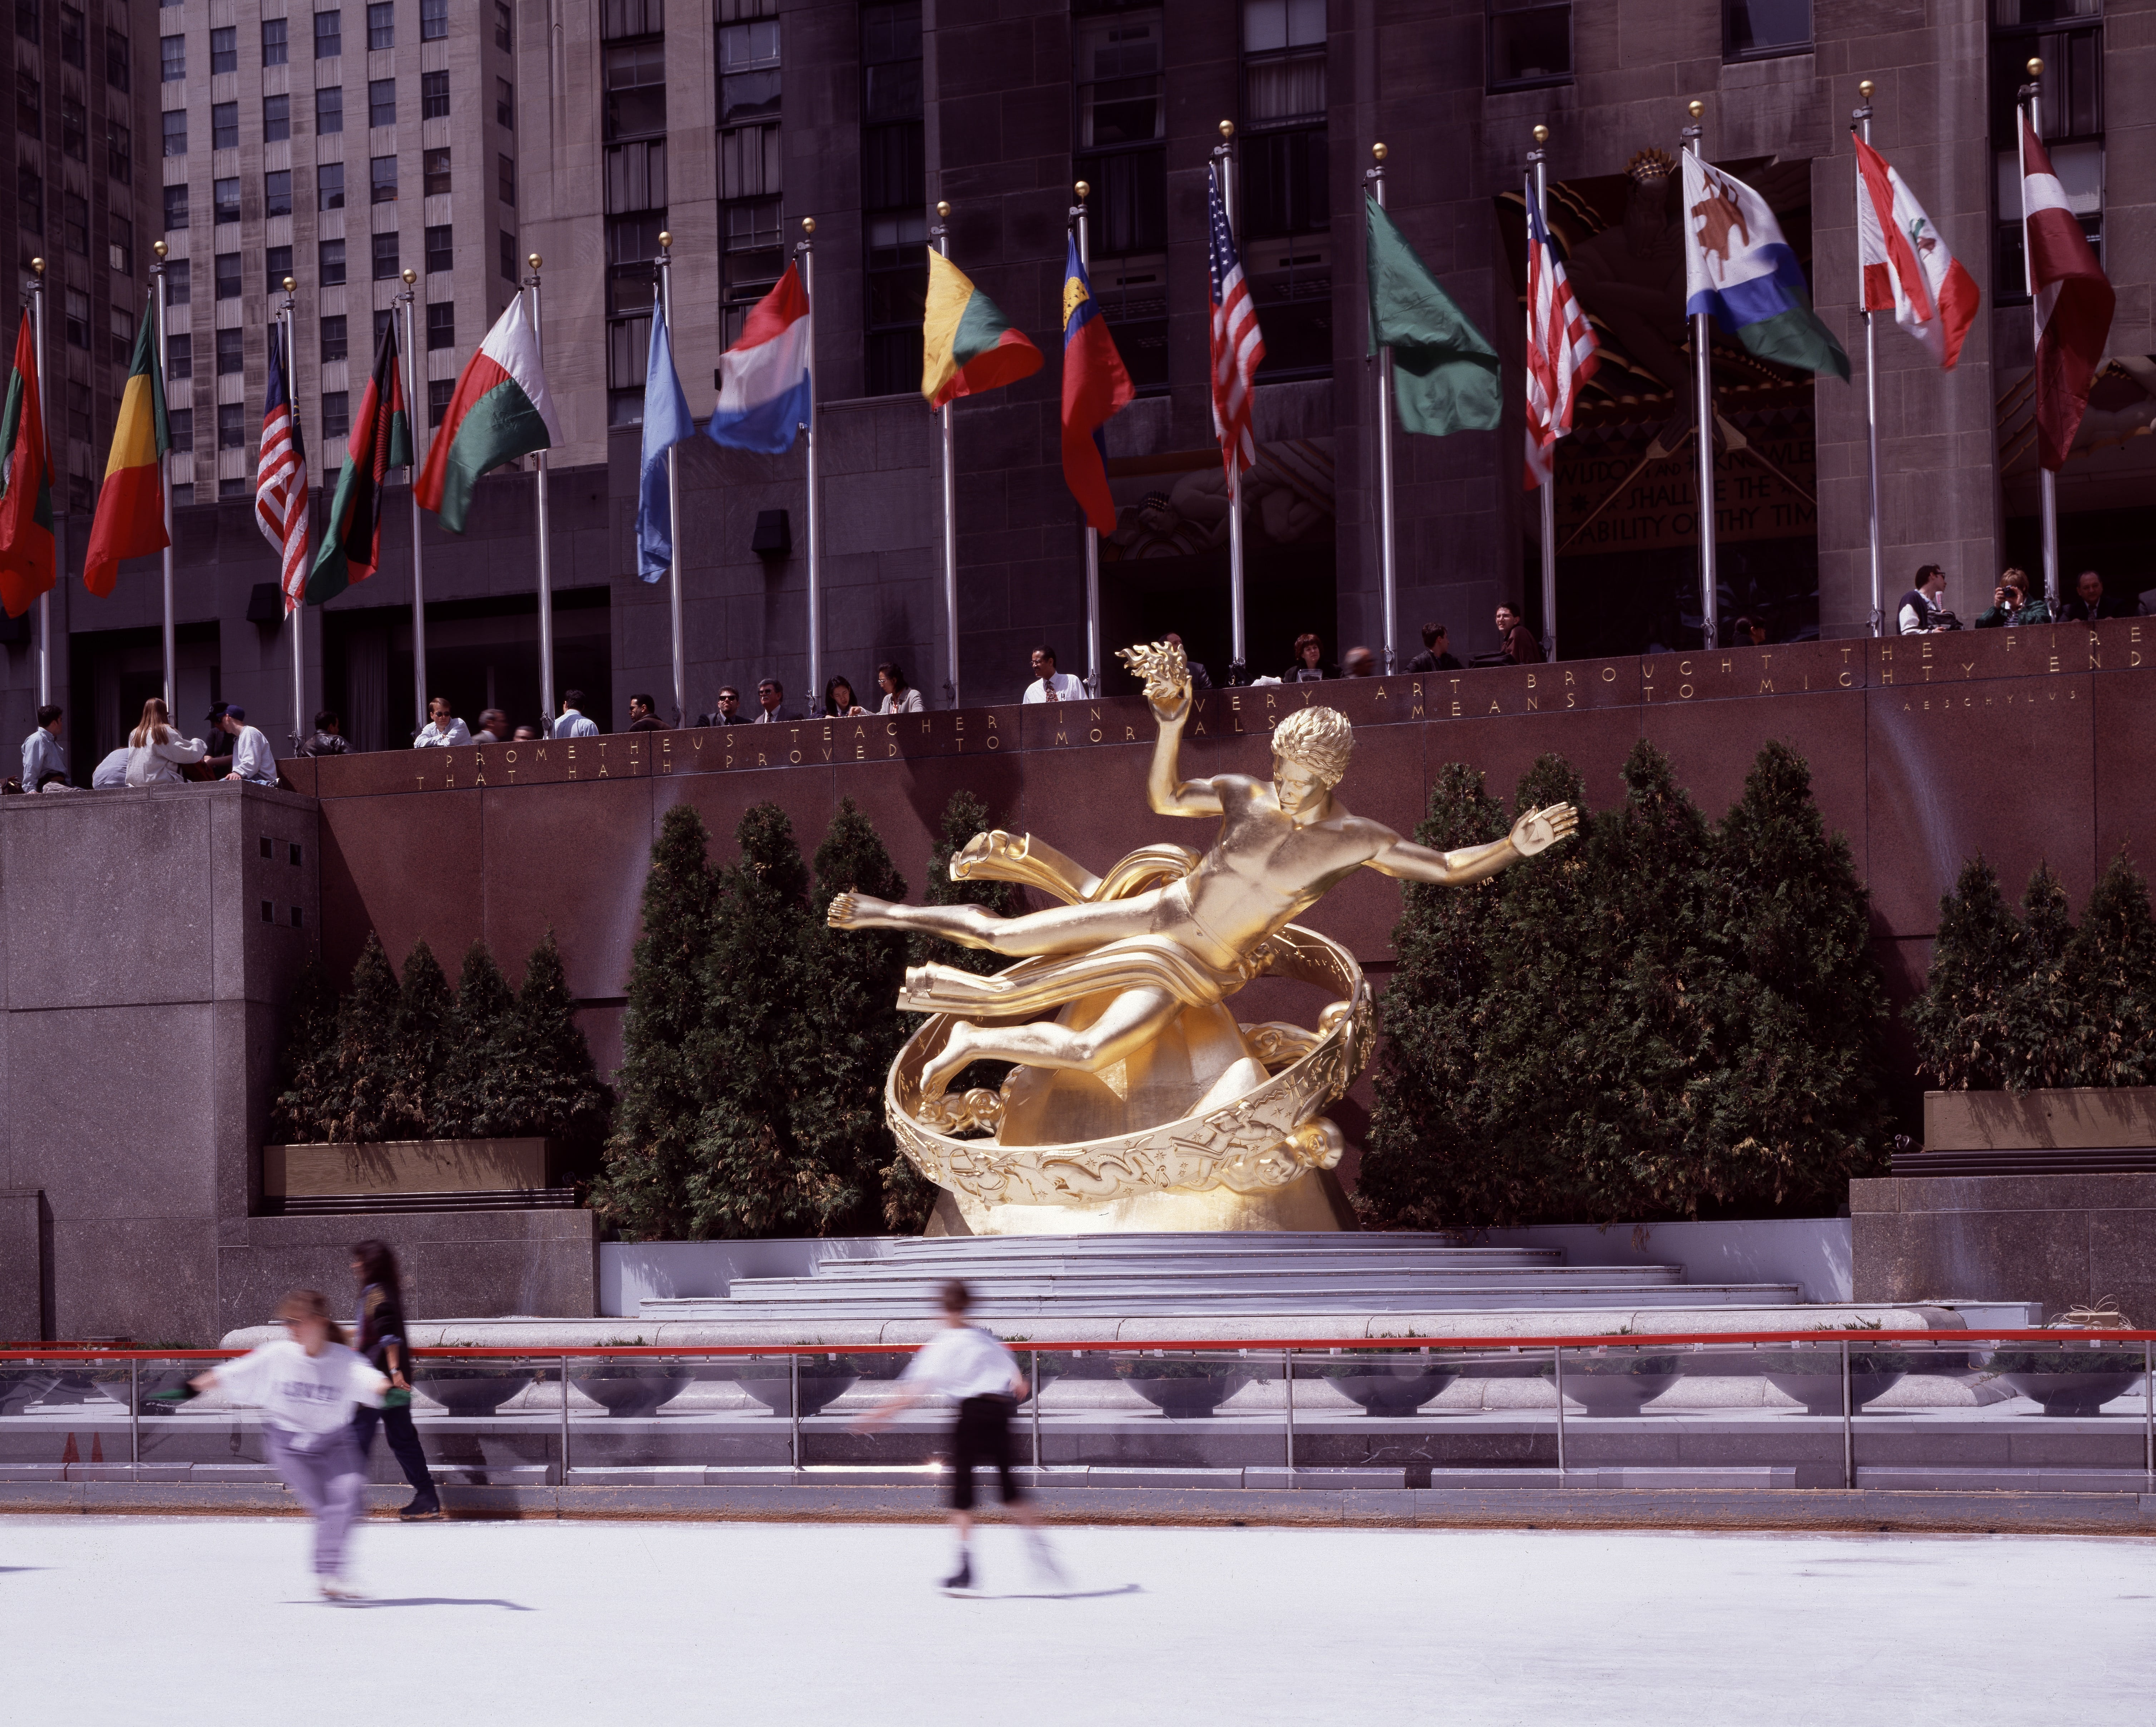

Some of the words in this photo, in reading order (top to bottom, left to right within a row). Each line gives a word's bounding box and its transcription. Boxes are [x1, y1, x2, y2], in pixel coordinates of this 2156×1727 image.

[1655, 463, 1681, 478] AND
[1713, 440, 1816, 471] KNWLE
[1627, 483, 1693, 510] SHALL
[1734, 475, 1771, 499] THE
[1555, 515, 1667, 545] STABILITY
[1715, 506, 1761, 532] THY
[446, 734, 733, 767] PROMETHEUS
[790, 715, 997, 742] TEACHER
[1060, 706, 1100, 723] IN
[1195, 690, 1313, 712] VERY
[1375, 679, 1460, 699] ART
[1528, 655, 1772, 688] BROUGHT
[1840, 642, 1932, 663] THE
[2006, 627, 2141, 651] FIRE
[1903, 690, 2076, 711] AESCHYLUS
[416, 770, 516, 789] THAT
[568, 759, 671, 779] HATH
[726, 744, 897, 768] PROVED
[955, 736, 1000, 752] TO
[1055, 715, 1276, 745] MORALS
[1411, 693, 1575, 719] MEANS
[1643, 684, 1694, 701] TO
[1759, 662, 1974, 693] MIGHTY
